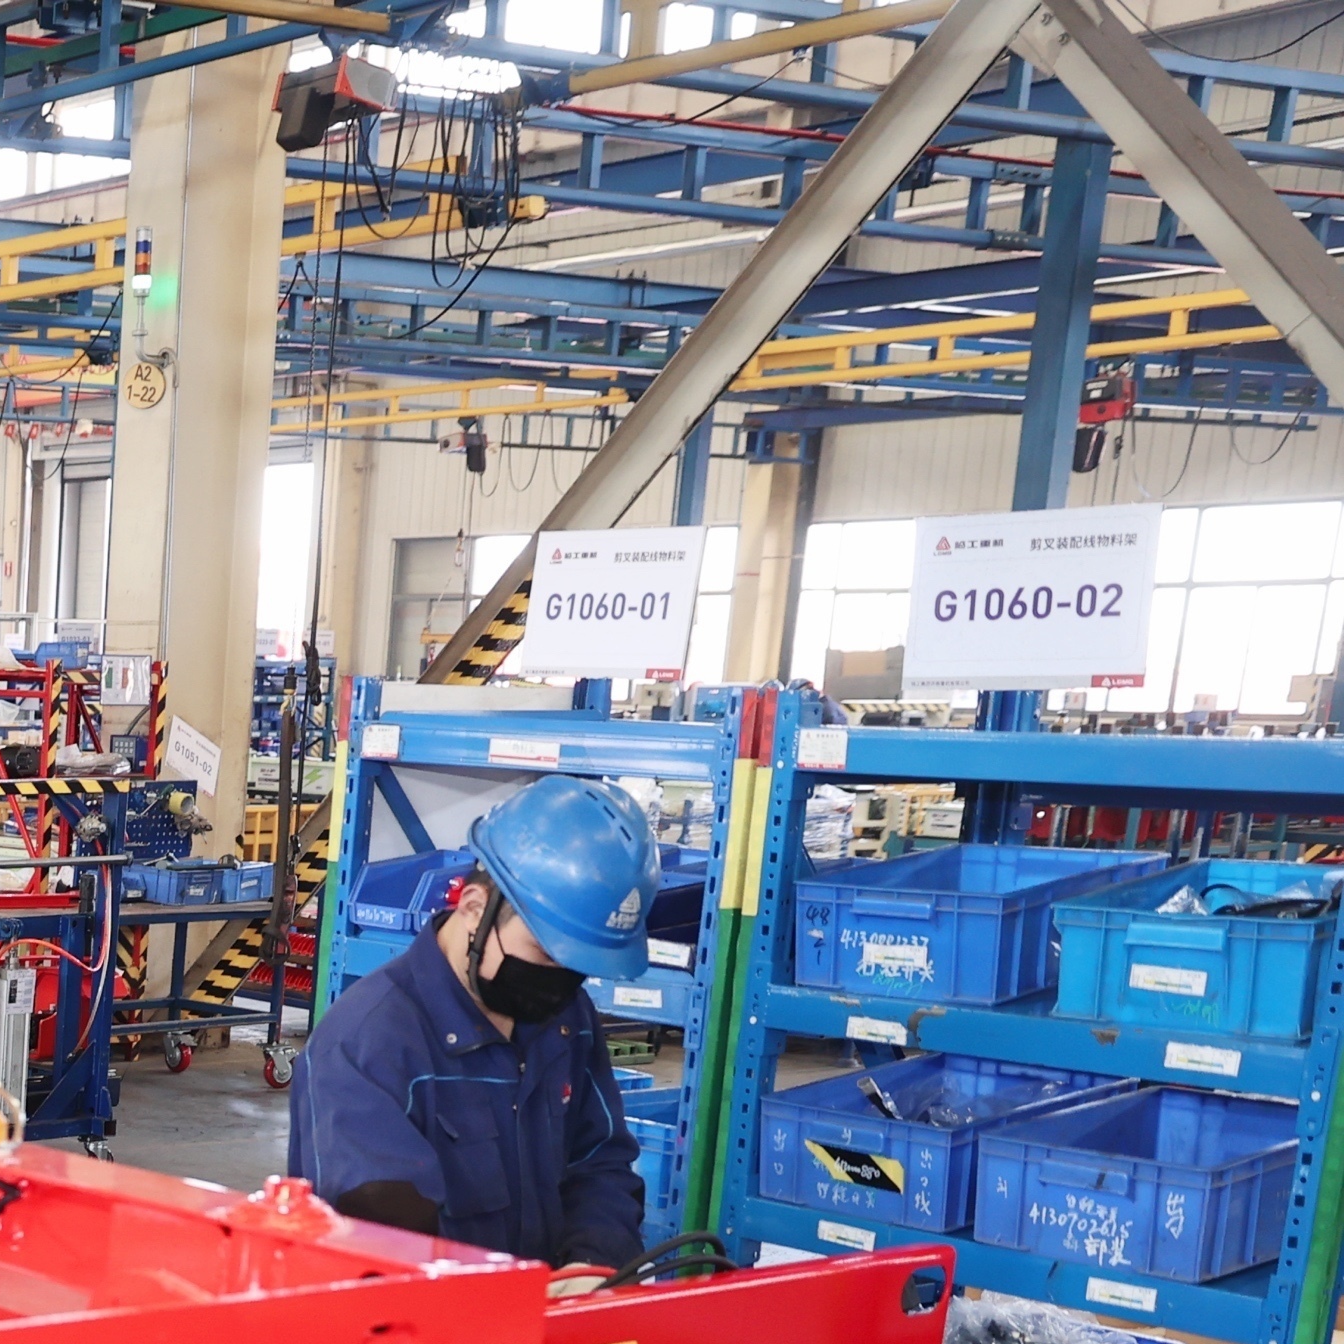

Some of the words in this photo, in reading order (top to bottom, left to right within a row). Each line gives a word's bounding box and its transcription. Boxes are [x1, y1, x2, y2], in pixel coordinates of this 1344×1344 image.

[135, 364, 152, 381] A2
[127, 384, 156, 403] 1-22
[954, 538, 1004, 549] 临工重机
[1030, 533, 1138, 552] 剪叉装配线物料架
[564, 552, 597, 560] 临工重机
[614, 551, 686, 563] 剪叉装配线物料架
[546, 592, 671, 620] G1060-01
[934, 583, 1124, 622] G1060-02
[174, 740, 212, 776] G1051-02
